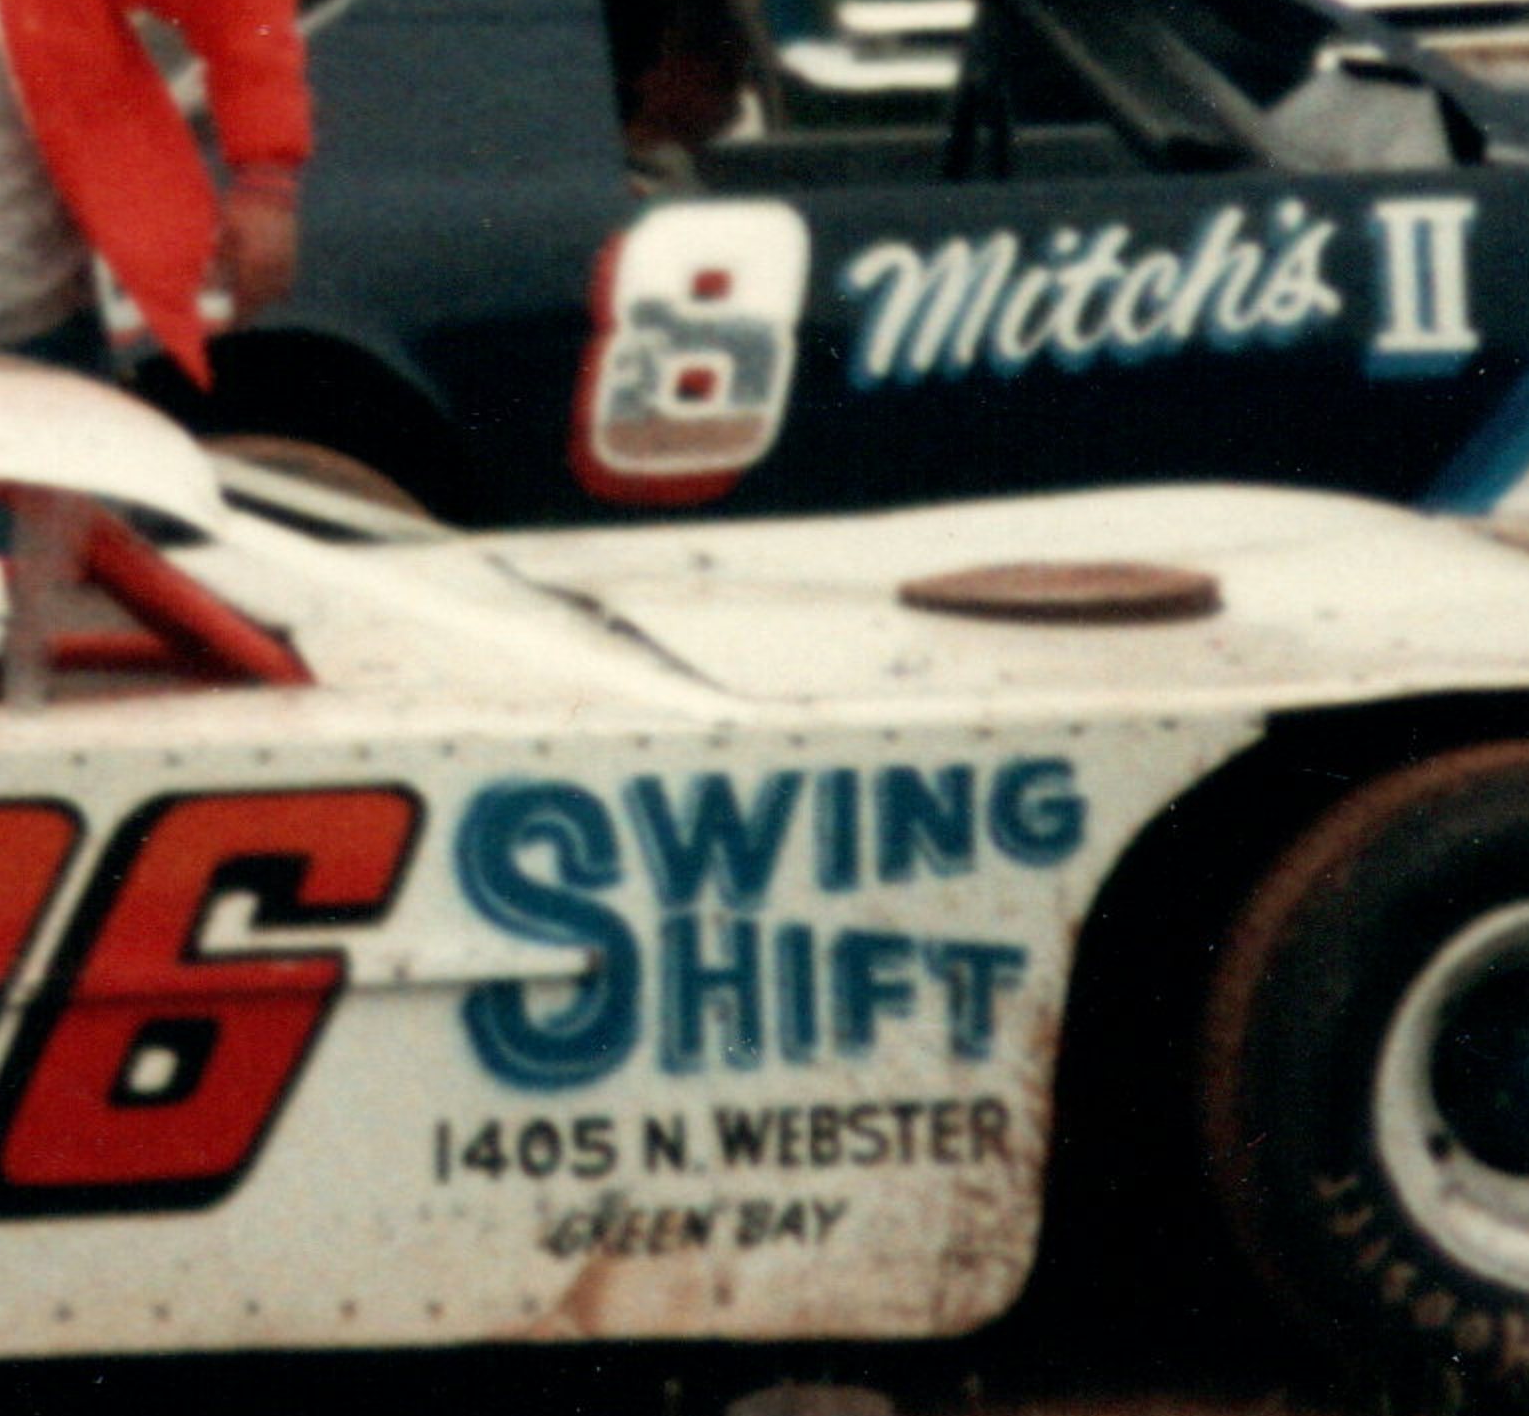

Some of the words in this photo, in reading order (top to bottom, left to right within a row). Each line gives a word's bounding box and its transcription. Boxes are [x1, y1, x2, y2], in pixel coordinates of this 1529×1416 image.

[569, 200, 811, 505] 8
[848, 196, 1340, 383] Mitch's
[434, 1115, 619, 1185] 1405
[713, 1098, 1013, 1170] WEBSTER
[735, 1194, 848, 1250] BAY
